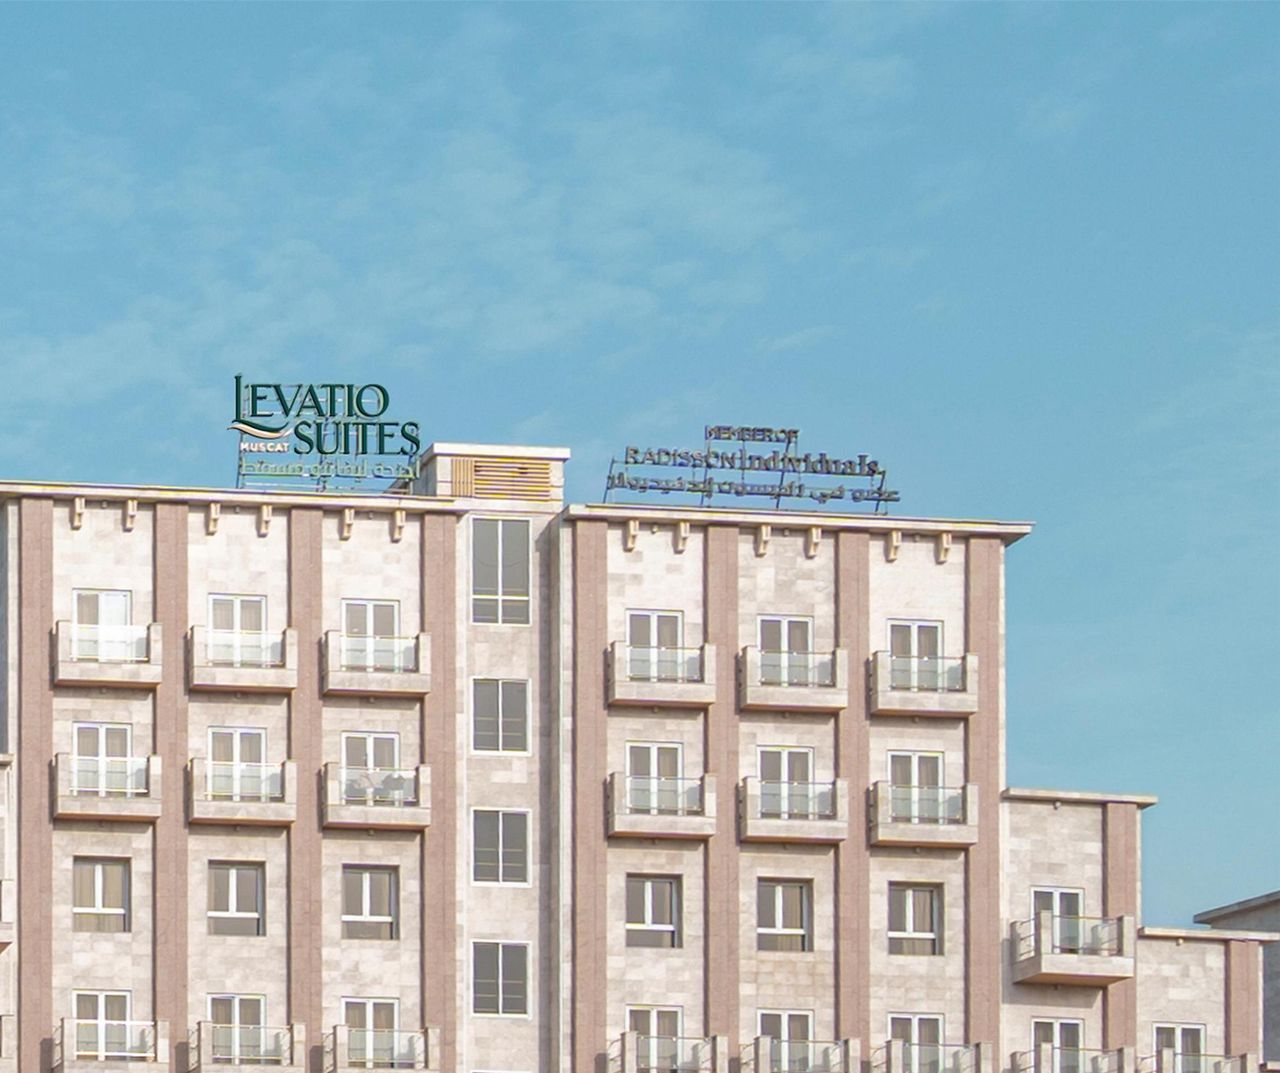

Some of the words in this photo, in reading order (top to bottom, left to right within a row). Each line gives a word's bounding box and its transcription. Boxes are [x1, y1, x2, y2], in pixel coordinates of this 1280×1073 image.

[233, 375, 390, 419] LEVATIO
[241, 441, 290, 453] MUSCAT
[293, 420, 421, 455] SUITES
[625, 446, 737, 468] RADISSON
